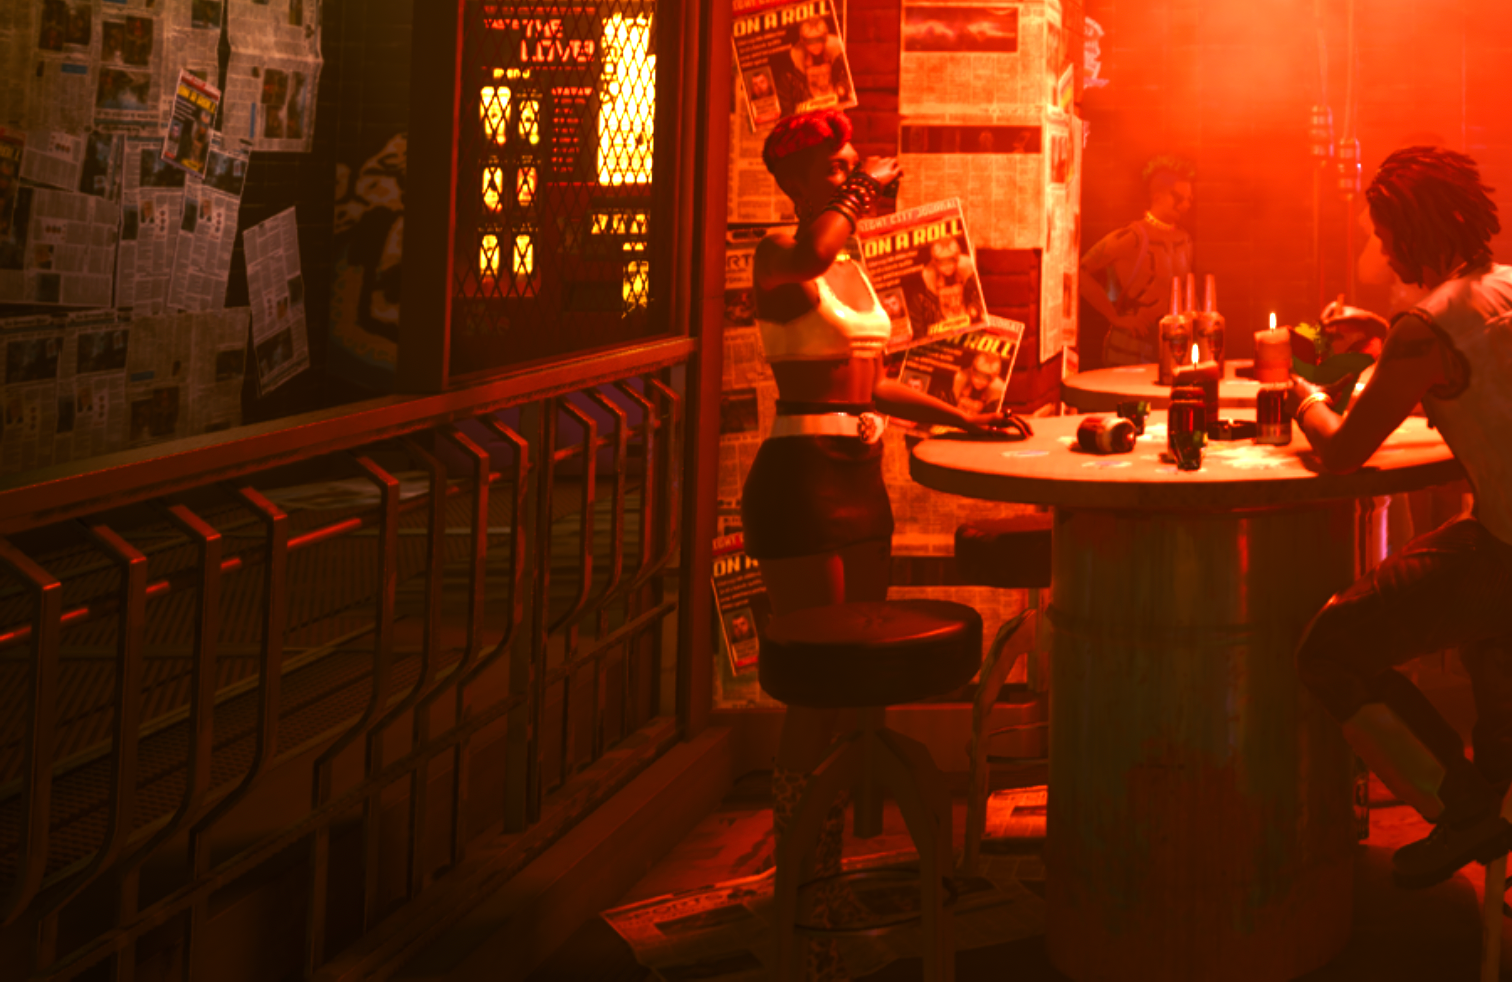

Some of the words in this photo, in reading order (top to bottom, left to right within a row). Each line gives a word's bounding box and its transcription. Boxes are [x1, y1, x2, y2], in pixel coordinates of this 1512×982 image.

[733, 16, 760, 37] ON
[763, 12, 778, 30] A
[780, 0, 830, 26] ROLL
[864, 237, 892, 259] ON
[895, 232, 910, 250] A
[913, 218, 963, 246] ROLL
[713, 555, 741, 578] ON
